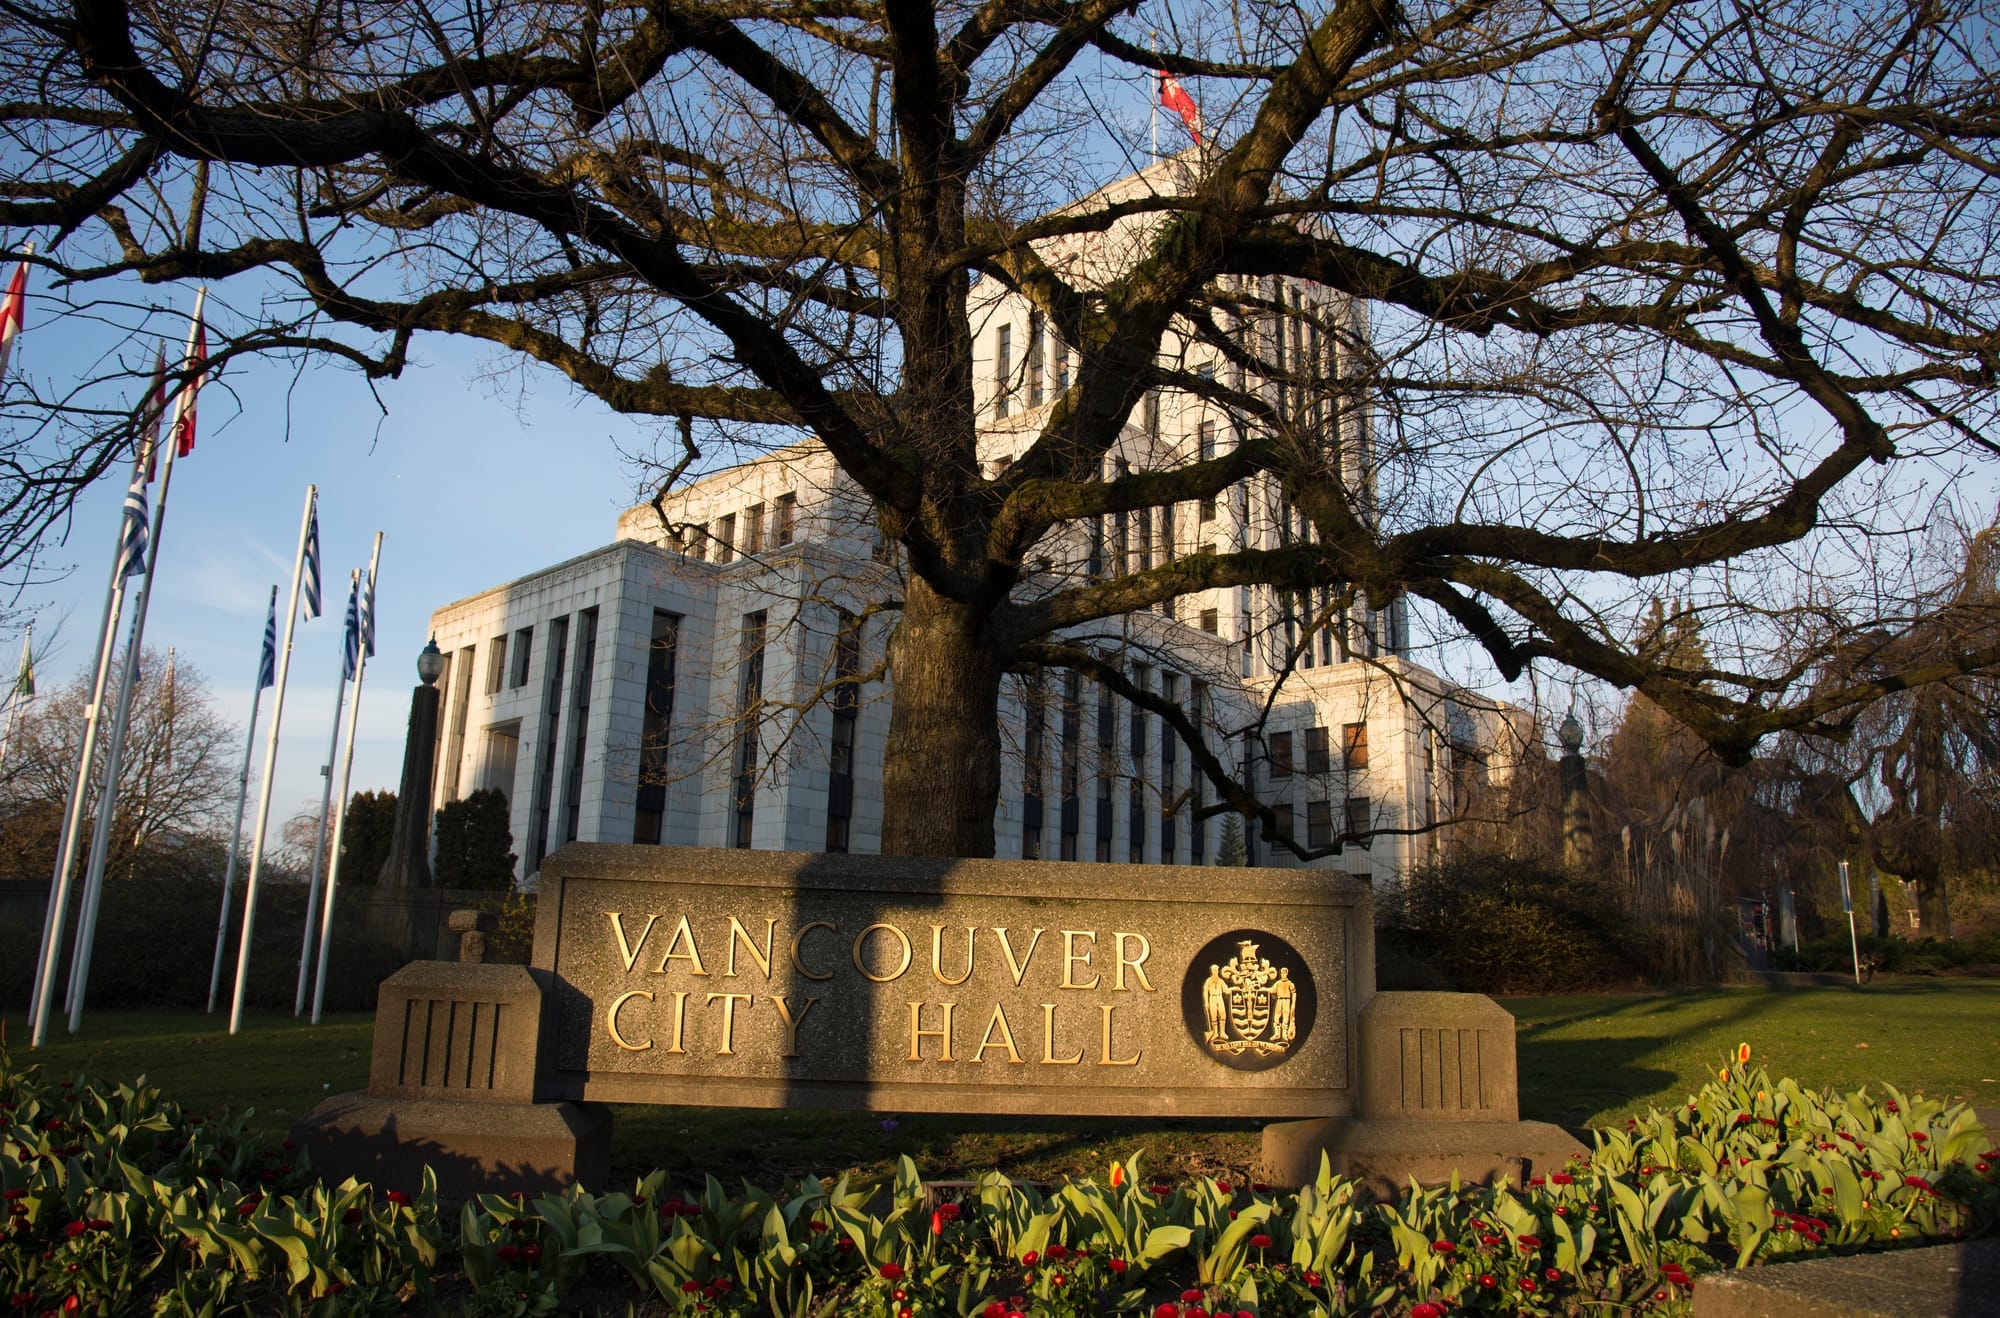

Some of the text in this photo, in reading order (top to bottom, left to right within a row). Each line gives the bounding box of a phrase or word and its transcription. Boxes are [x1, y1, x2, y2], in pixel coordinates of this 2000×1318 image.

[604, 911, 1157, 992] VANCOUVER
[607, 990, 1143, 1067] CITY HALL
